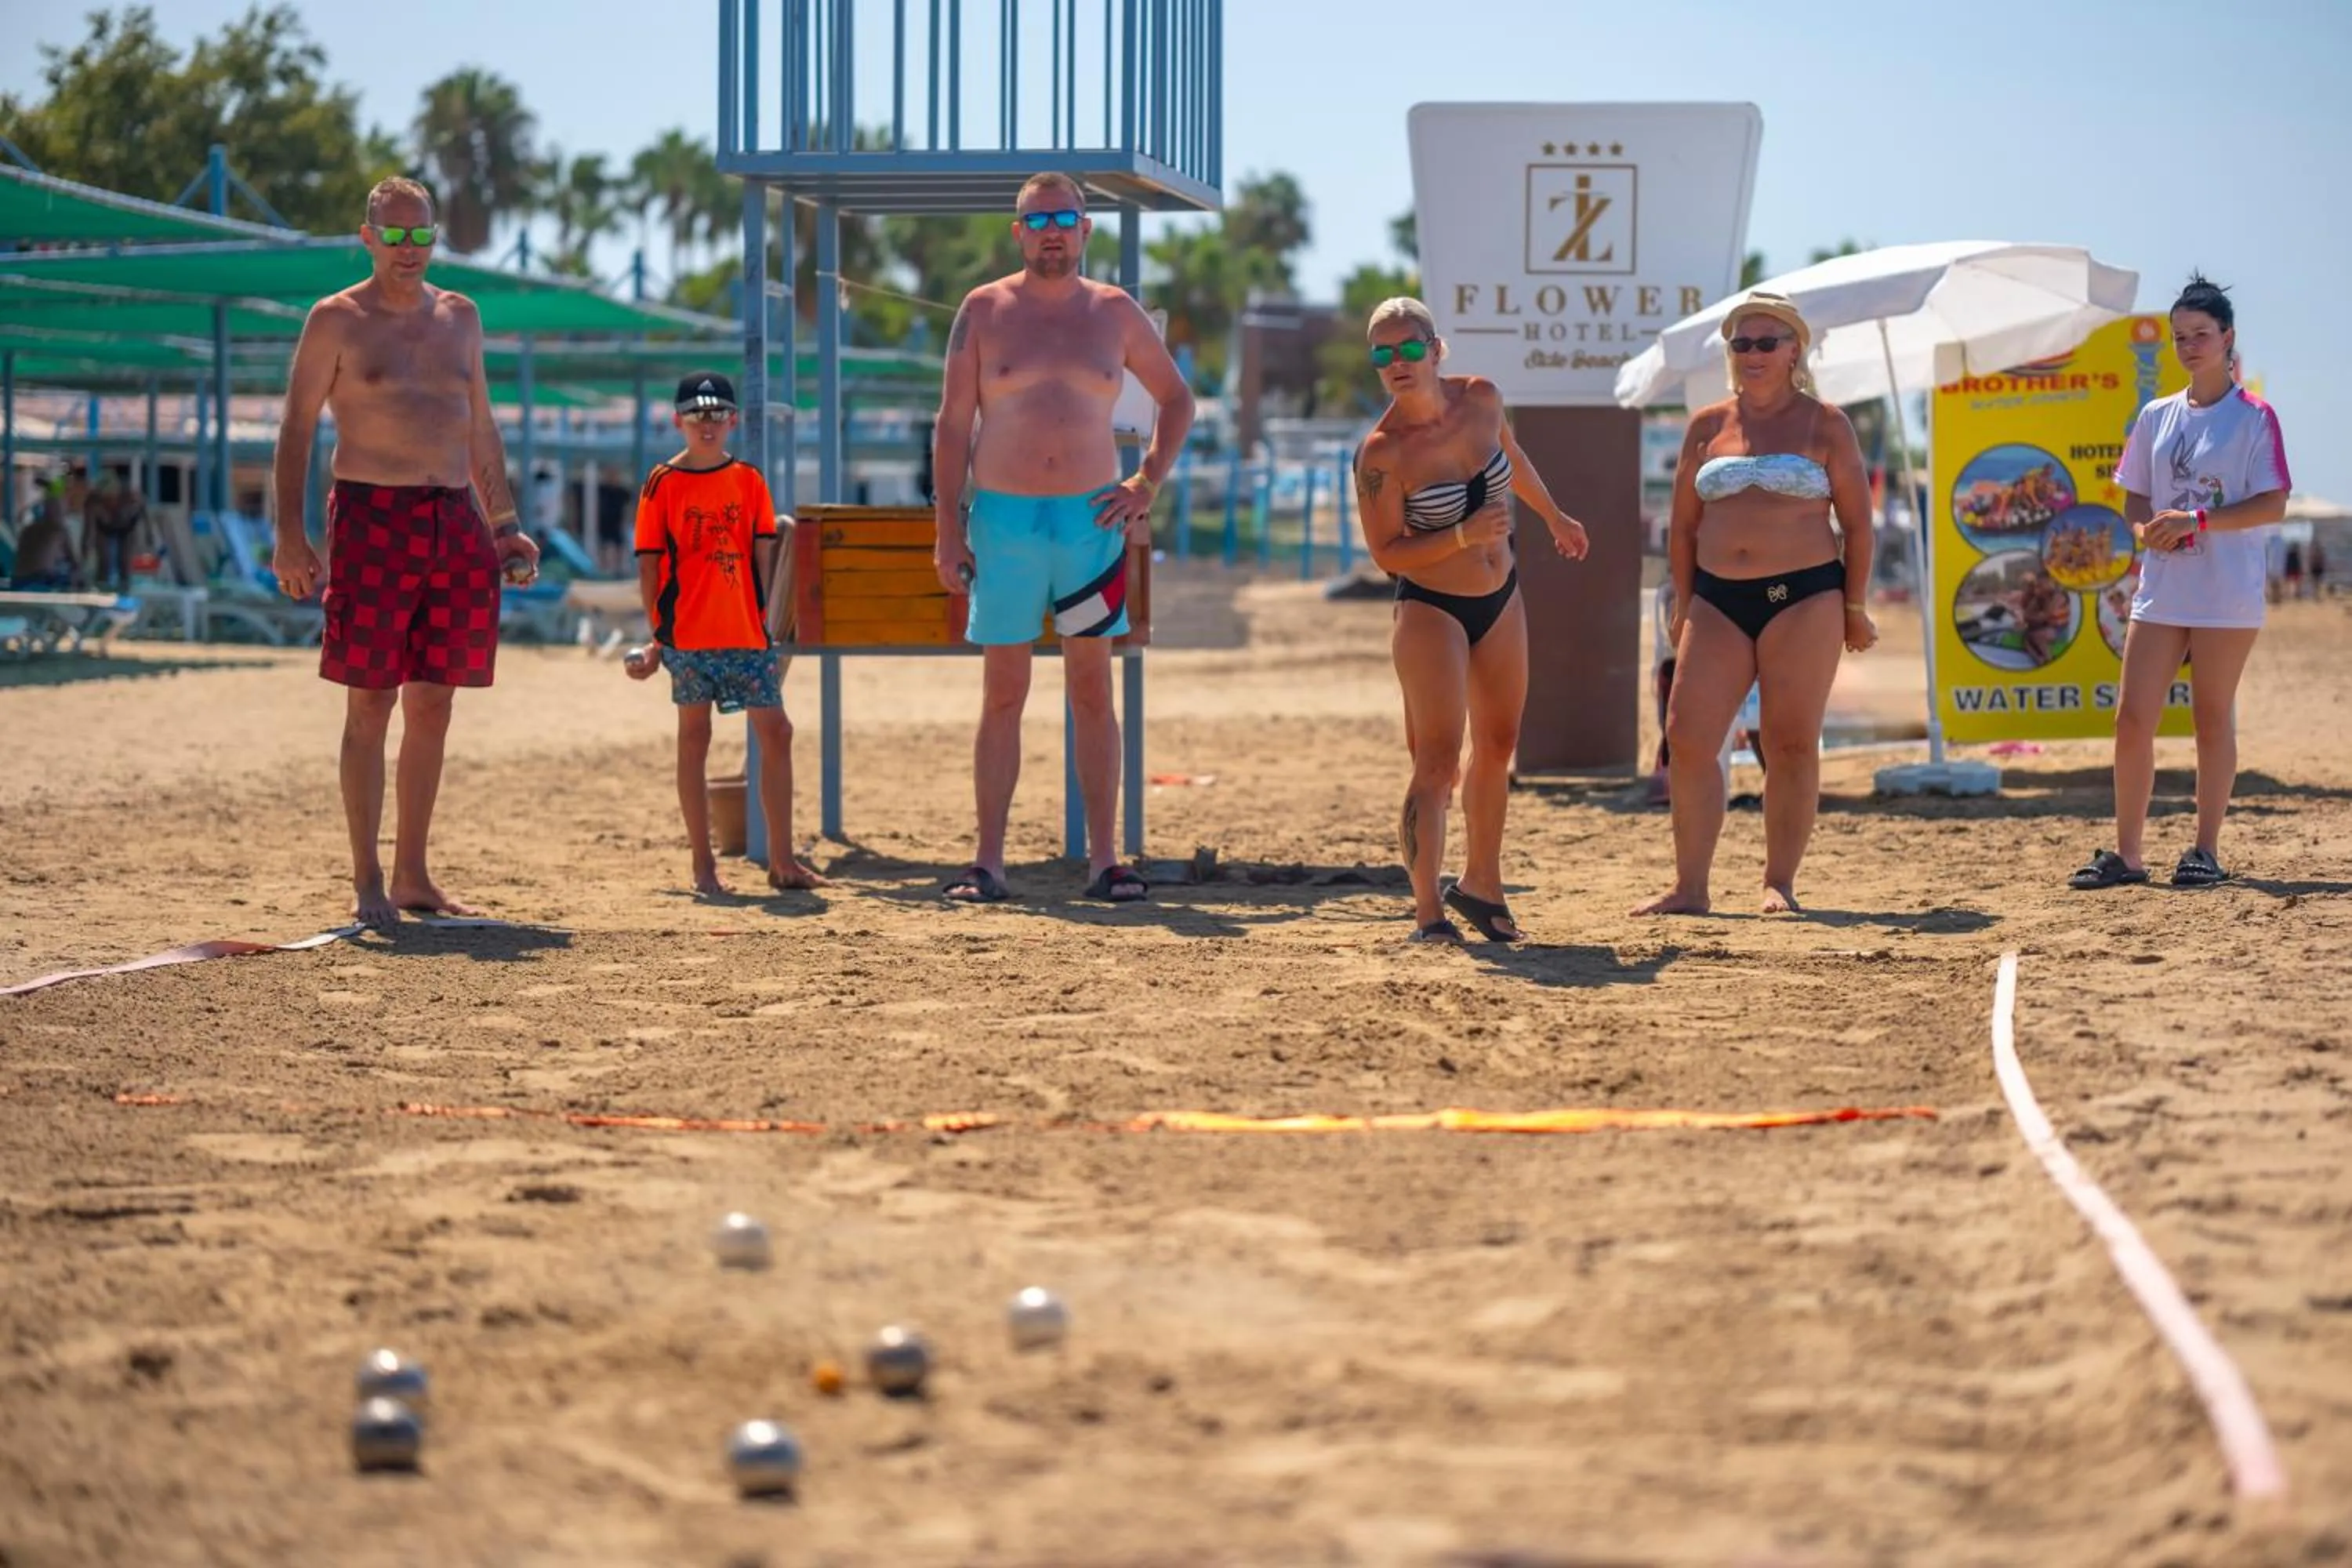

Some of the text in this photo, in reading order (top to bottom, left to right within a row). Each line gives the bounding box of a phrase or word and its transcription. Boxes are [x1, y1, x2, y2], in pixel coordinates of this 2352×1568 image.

[1455, 284, 1704, 315] FLOWER
[1524, 322, 1637, 341] HOTEL
[1955, 686, 2080, 711] WATER
